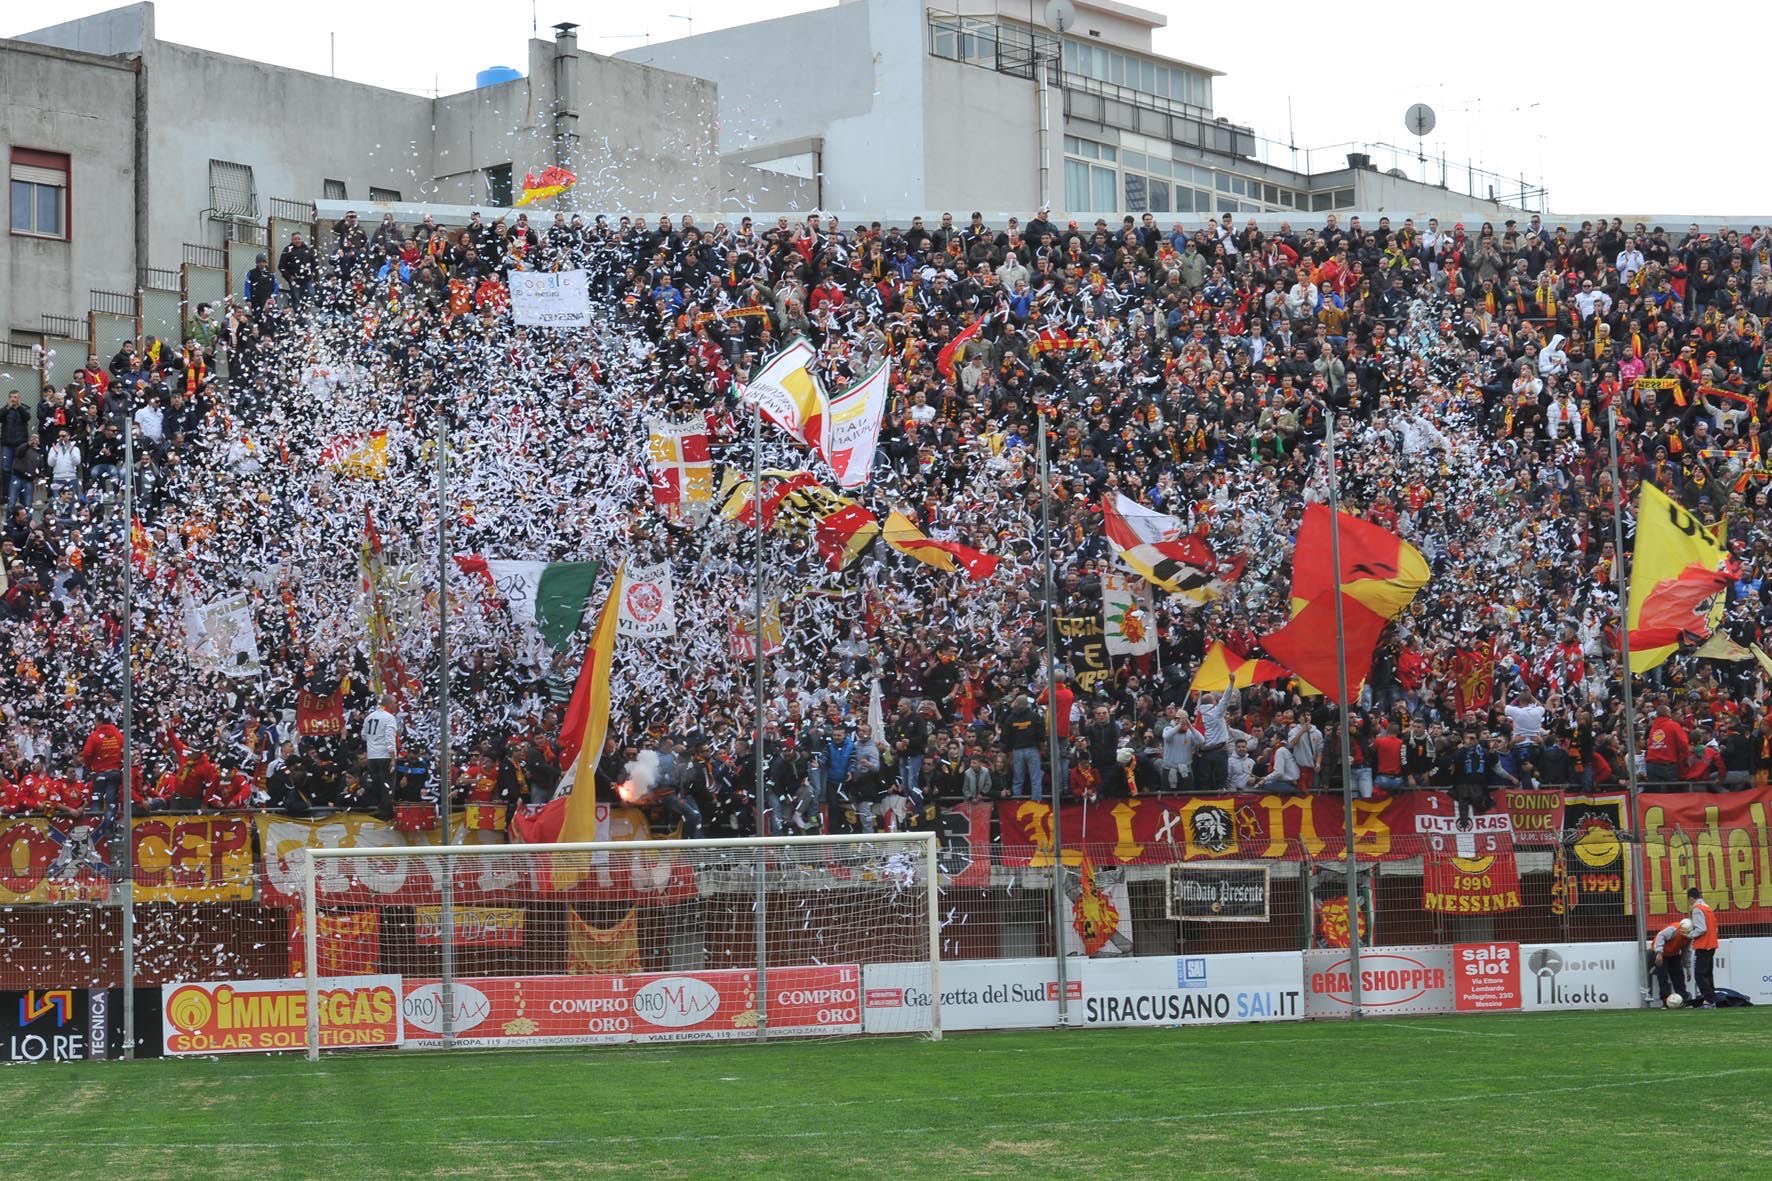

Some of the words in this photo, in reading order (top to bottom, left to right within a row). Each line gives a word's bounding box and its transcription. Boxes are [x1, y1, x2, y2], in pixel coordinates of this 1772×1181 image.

[366, 718, 381, 736] 17
[1505, 793, 1560, 809] TONINO
[1454, 875, 1492, 891] 1990
[1581, 873, 1620, 892] 1990
[1220, 880, 1264, 906] Presente
[1424, 891, 1520, 912] MESSINA
[1462, 945, 1510, 960] sala
[1465, 960, 1510, 976] slot
[839, 970, 856, 983] IL
[612, 979, 629, 992] IL
[982, 984, 1008, 1004] del
[1011, 982, 1046, 1003] Sud
[778, 988, 857, 1005] COMPRO
[549, 998, 629, 1014] COMPRO
[1087, 993, 1230, 1022] SIRACUSANO
[92, 992, 105, 1055] TECNICA
[816, 1009, 857, 1023] ORO
[589, 1018, 629, 1032] ORO
[177, 1033, 252, 1050] SOLAR
